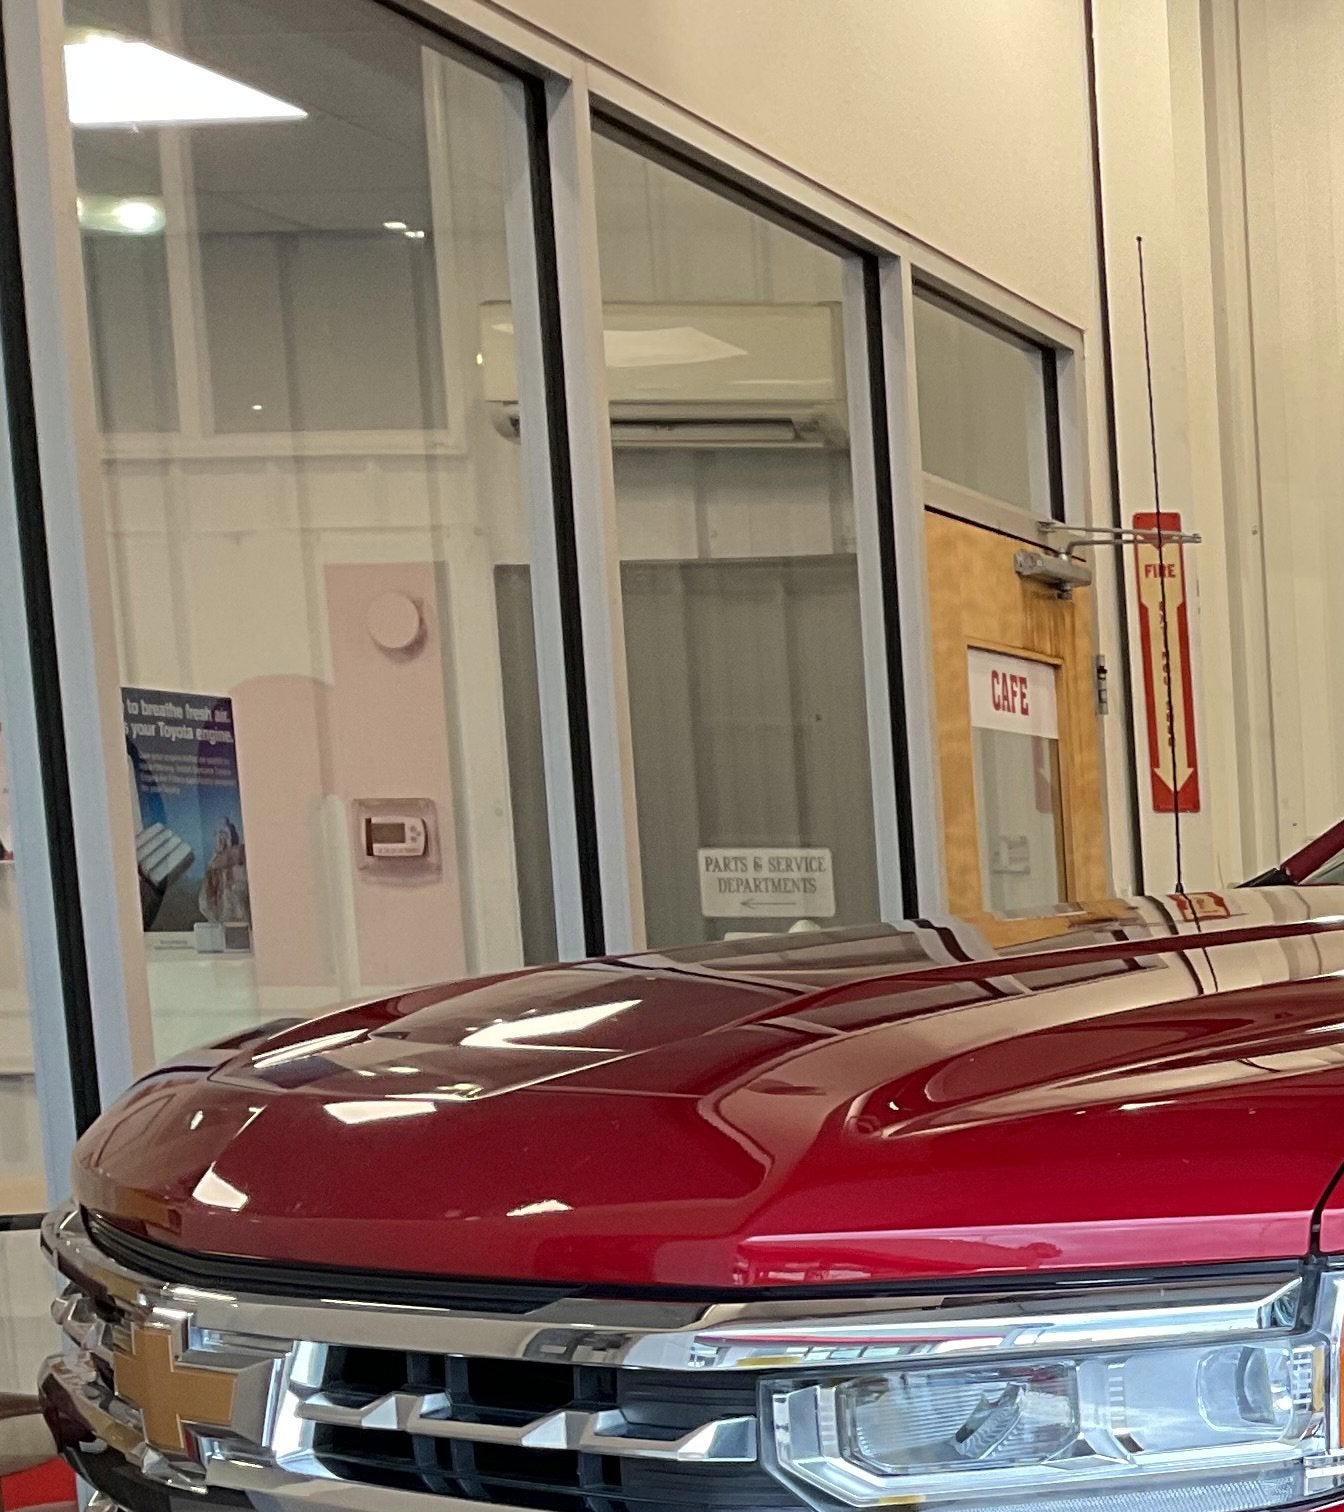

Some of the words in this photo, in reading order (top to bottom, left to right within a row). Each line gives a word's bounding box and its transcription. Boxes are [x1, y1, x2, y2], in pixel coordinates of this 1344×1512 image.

[991, 669, 1029, 716] CAFE
[126, 699, 139, 715] to
[141, 699, 184, 719] breathe
[185, 703, 213, 721] fresh
[130, 722, 156, 739] your
[157, 721, 194, 742] Toyota
[704, 855, 748, 873] PARTS
[753, 856, 763, 872] &
[768, 856, 827, 873] SERVICE
[717, 877, 818, 894] DEPARTMENTS
